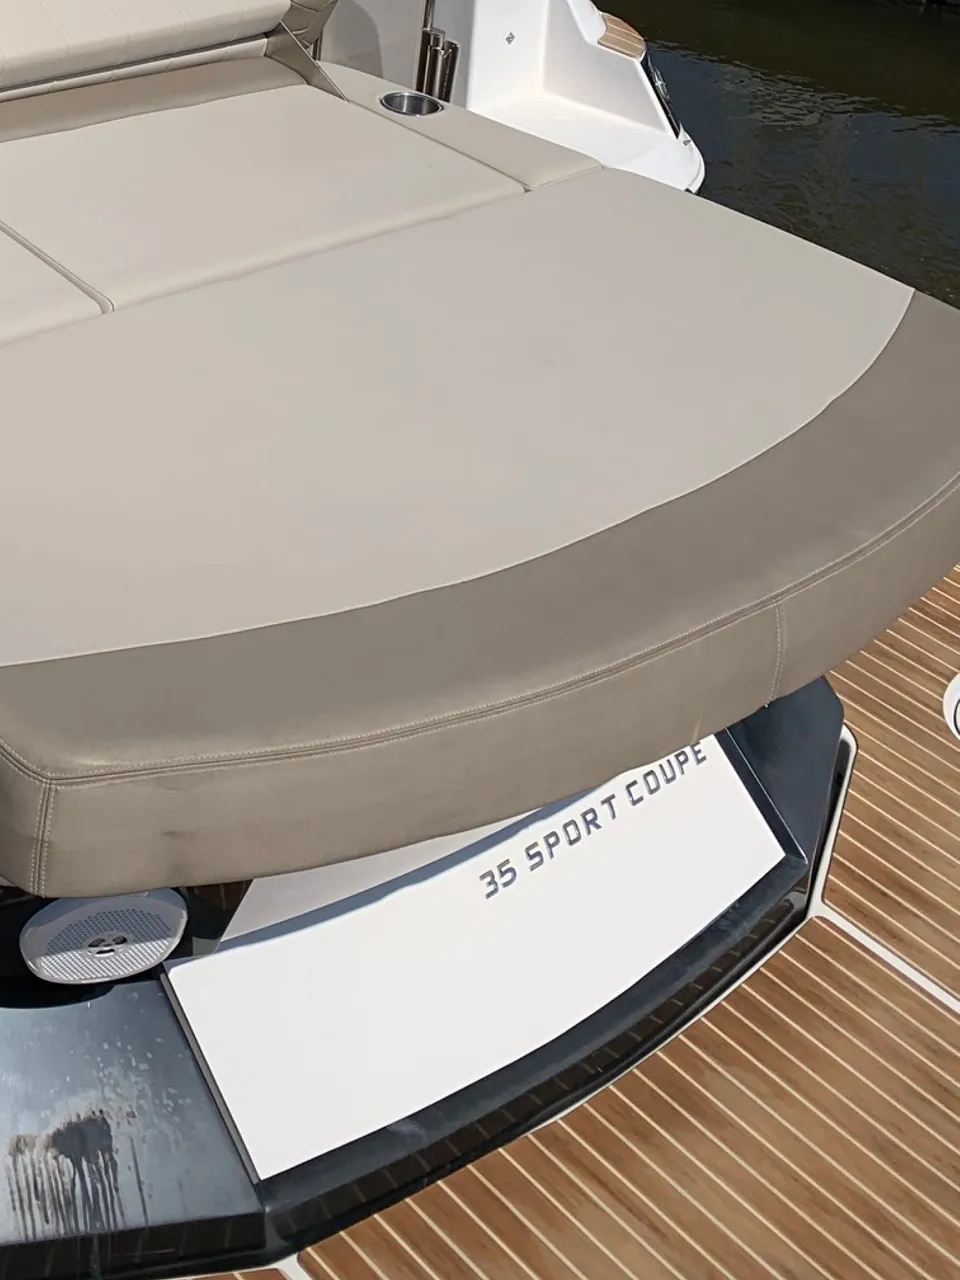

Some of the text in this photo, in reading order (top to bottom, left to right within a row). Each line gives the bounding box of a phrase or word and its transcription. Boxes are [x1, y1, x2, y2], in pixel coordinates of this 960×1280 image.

[479, 741, 707, 900] 35 SPORT COUPE
